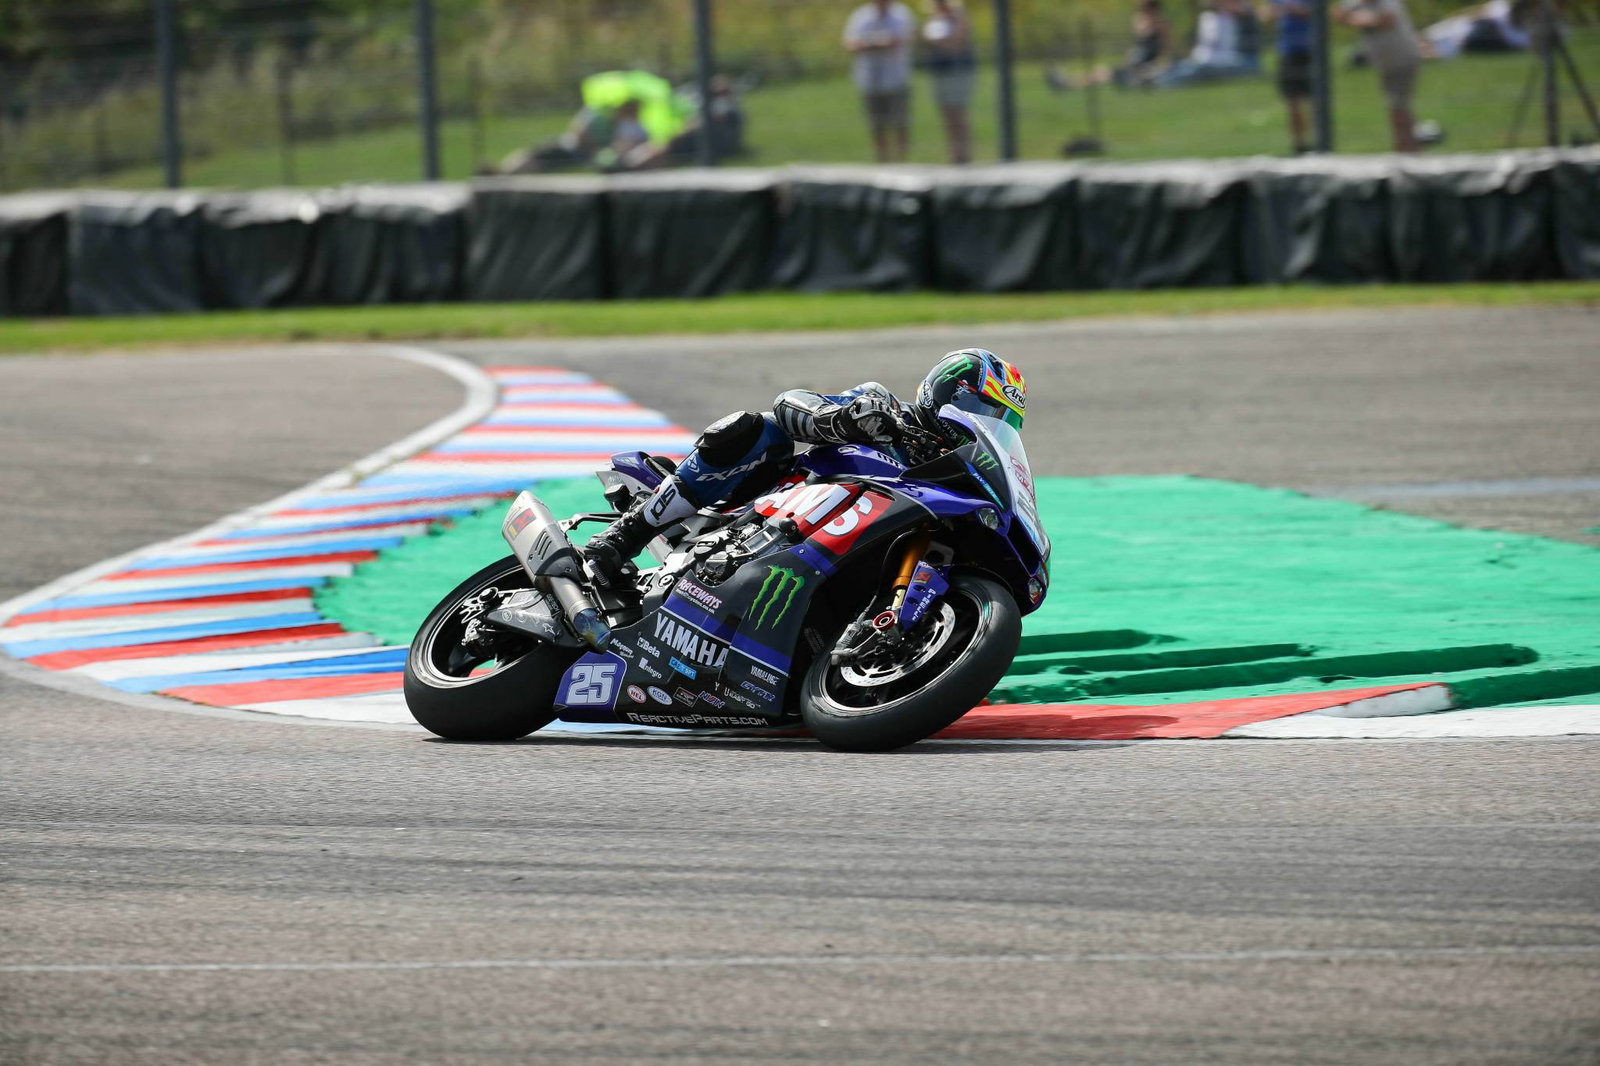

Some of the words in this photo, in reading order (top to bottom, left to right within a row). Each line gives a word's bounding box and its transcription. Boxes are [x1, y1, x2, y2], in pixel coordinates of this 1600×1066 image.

[678, 579, 722, 609] RACEWAYS
[642, 640, 660, 658] Beta
[654, 612, 729, 667] YAMAHA
[566, 663, 617, 705] 25
